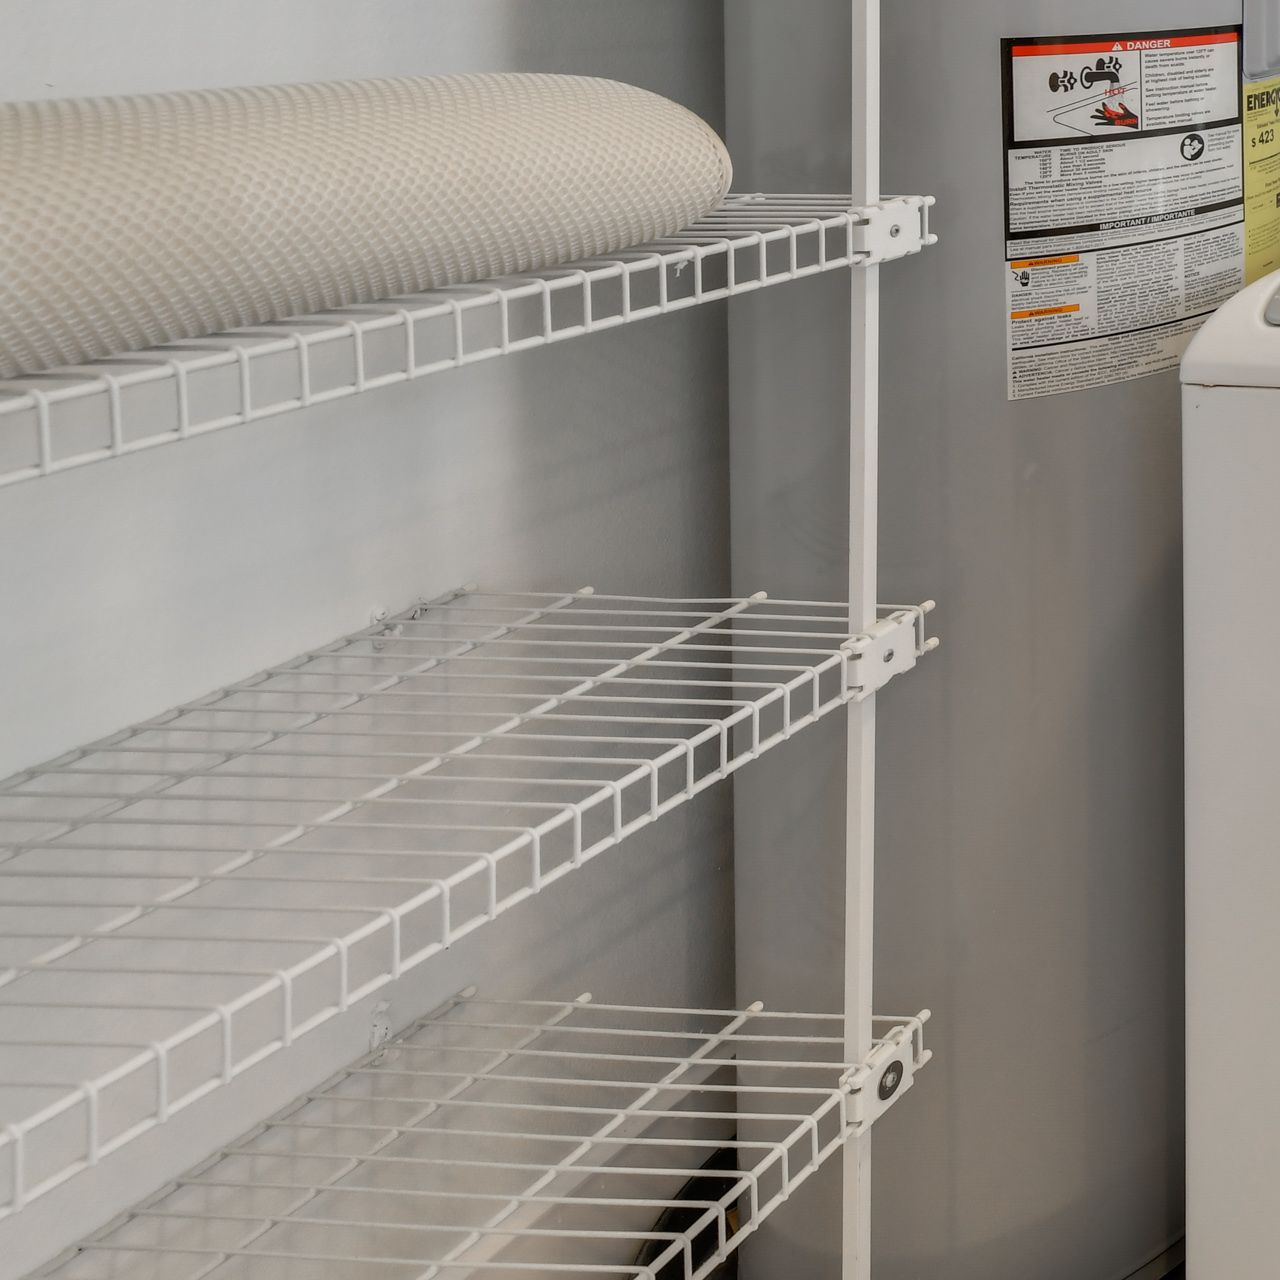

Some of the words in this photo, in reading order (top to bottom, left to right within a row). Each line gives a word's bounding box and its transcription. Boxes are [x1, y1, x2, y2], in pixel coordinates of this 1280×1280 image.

[1127, 40, 1170, 50] DANGER
[1104, 88, 1126, 96] HOT
[1115, 118, 1138, 126] BURN
[1259, 129, 1274, 144] 423
[1100, 216, 1146, 230] IMPORTANT
[1152, 209, 1196, 223] IMPORTANTE
